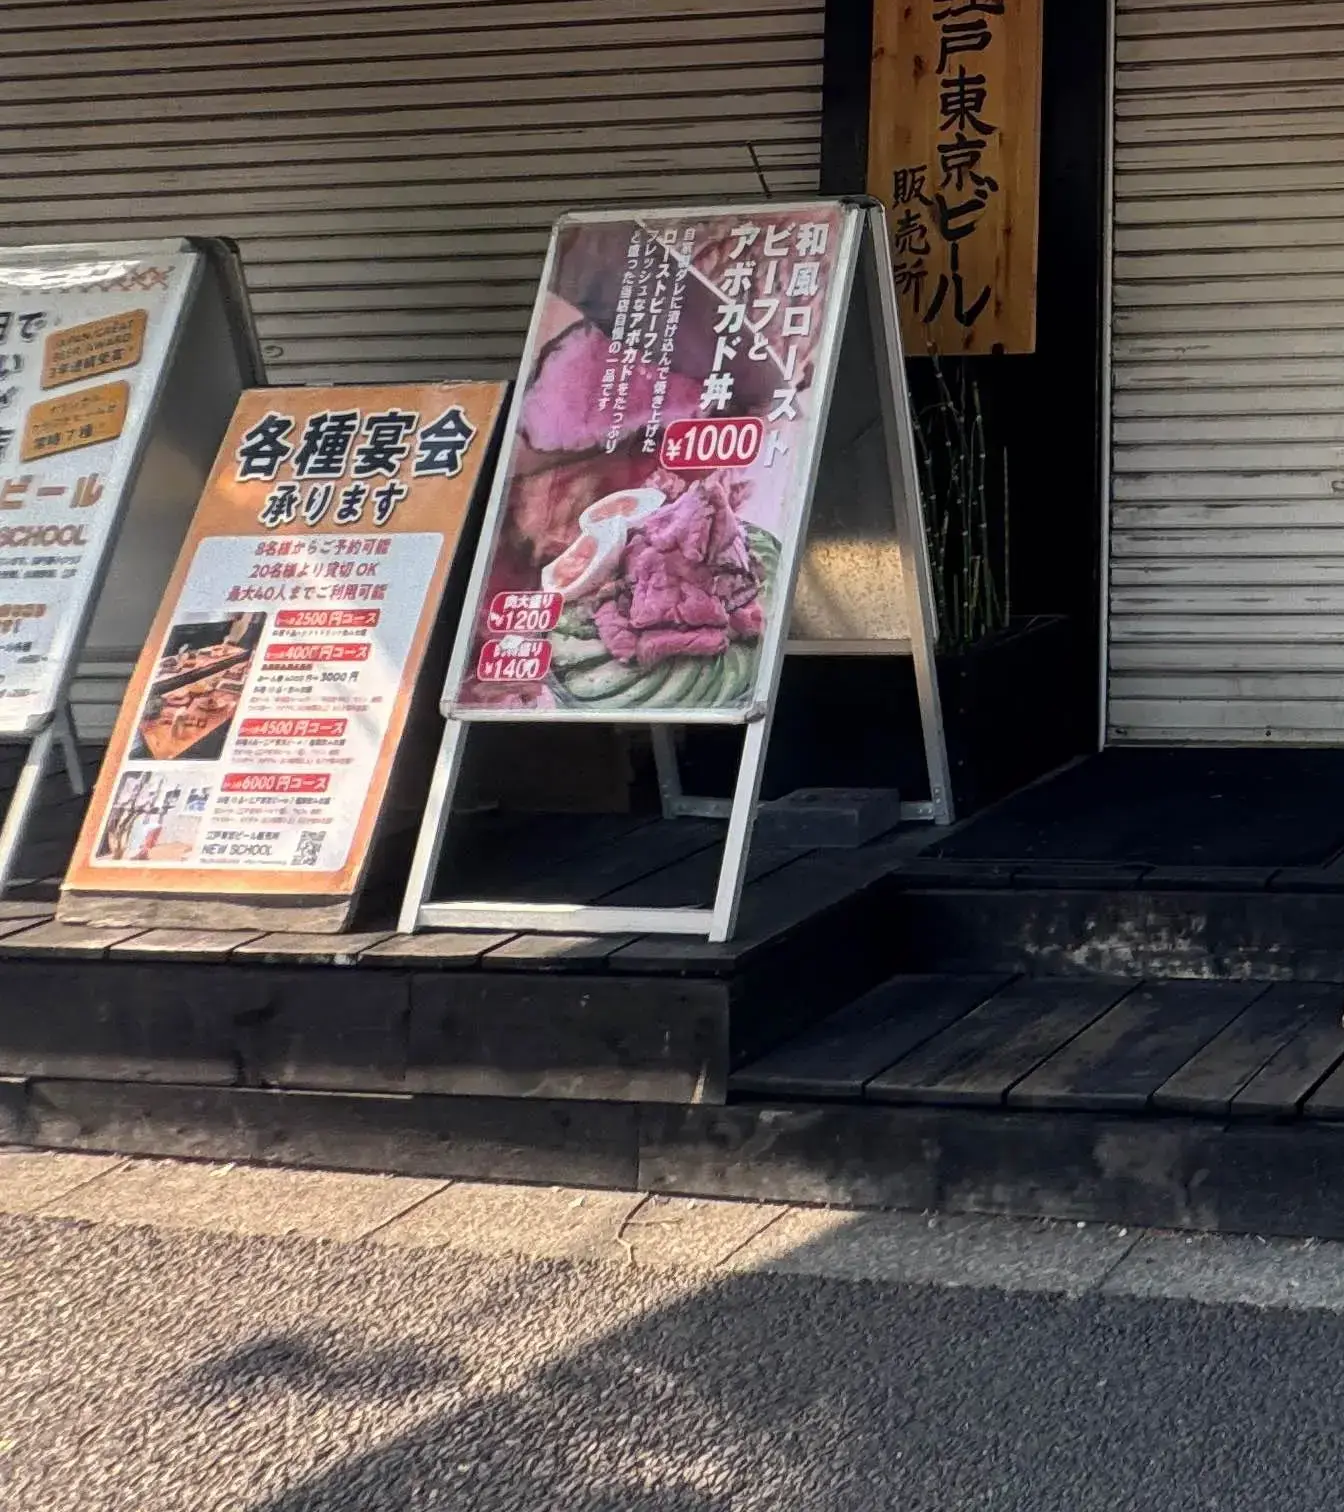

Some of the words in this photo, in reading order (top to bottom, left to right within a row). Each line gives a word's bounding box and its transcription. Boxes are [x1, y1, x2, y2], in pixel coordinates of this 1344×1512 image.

[640, 228, 678, 365] ローストビーフと
[747, 221, 796, 362] ビーフと
[893, 164, 935, 314] 販売所
[699, 221, 761, 412] アボカド丼
[763, 222, 830, 469] 和風ロースト
[237, 406, 476, 480] 各種宴会
[259, 482, 408, 526] 承ります
[666, 423, 759, 462] ¥1000
